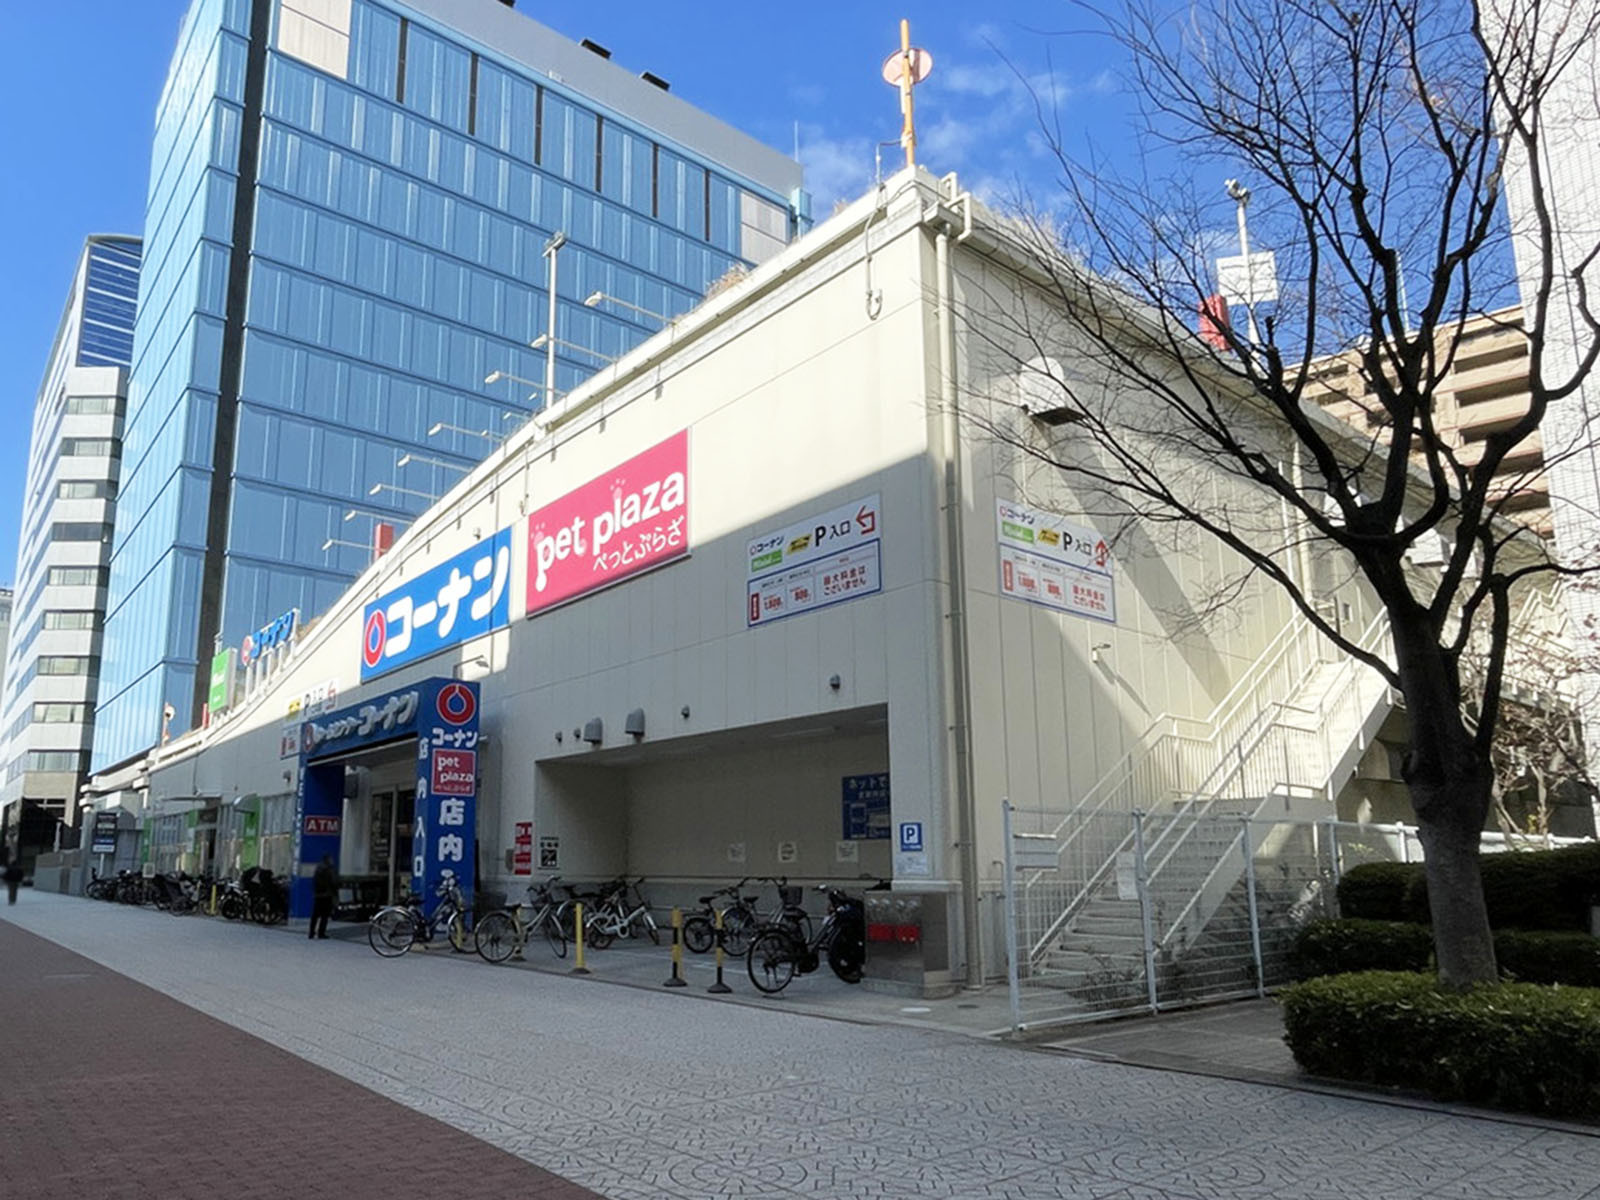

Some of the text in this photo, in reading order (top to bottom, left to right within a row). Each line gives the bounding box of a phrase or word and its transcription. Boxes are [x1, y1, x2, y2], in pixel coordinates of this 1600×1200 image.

[1006, 508, 1036, 525] コーナン
[535, 471, 685, 592] pet plaza
[814, 525, 827, 547] P
[829, 520, 851, 540] 入口
[757, 536, 784, 552] コーナン
[1063, 531, 1073, 551] P
[1075, 539, 1092, 556] 入口
[384, 545, 509, 658] コーナン
[432, 727, 478, 748] コーナン
[437, 756, 460, 771] pet
[440, 770, 474, 784] plaza
[413, 737, 429, 877] 店内入口
[307, 819, 339, 831] ATM
[906, 827, 915, 841] P
